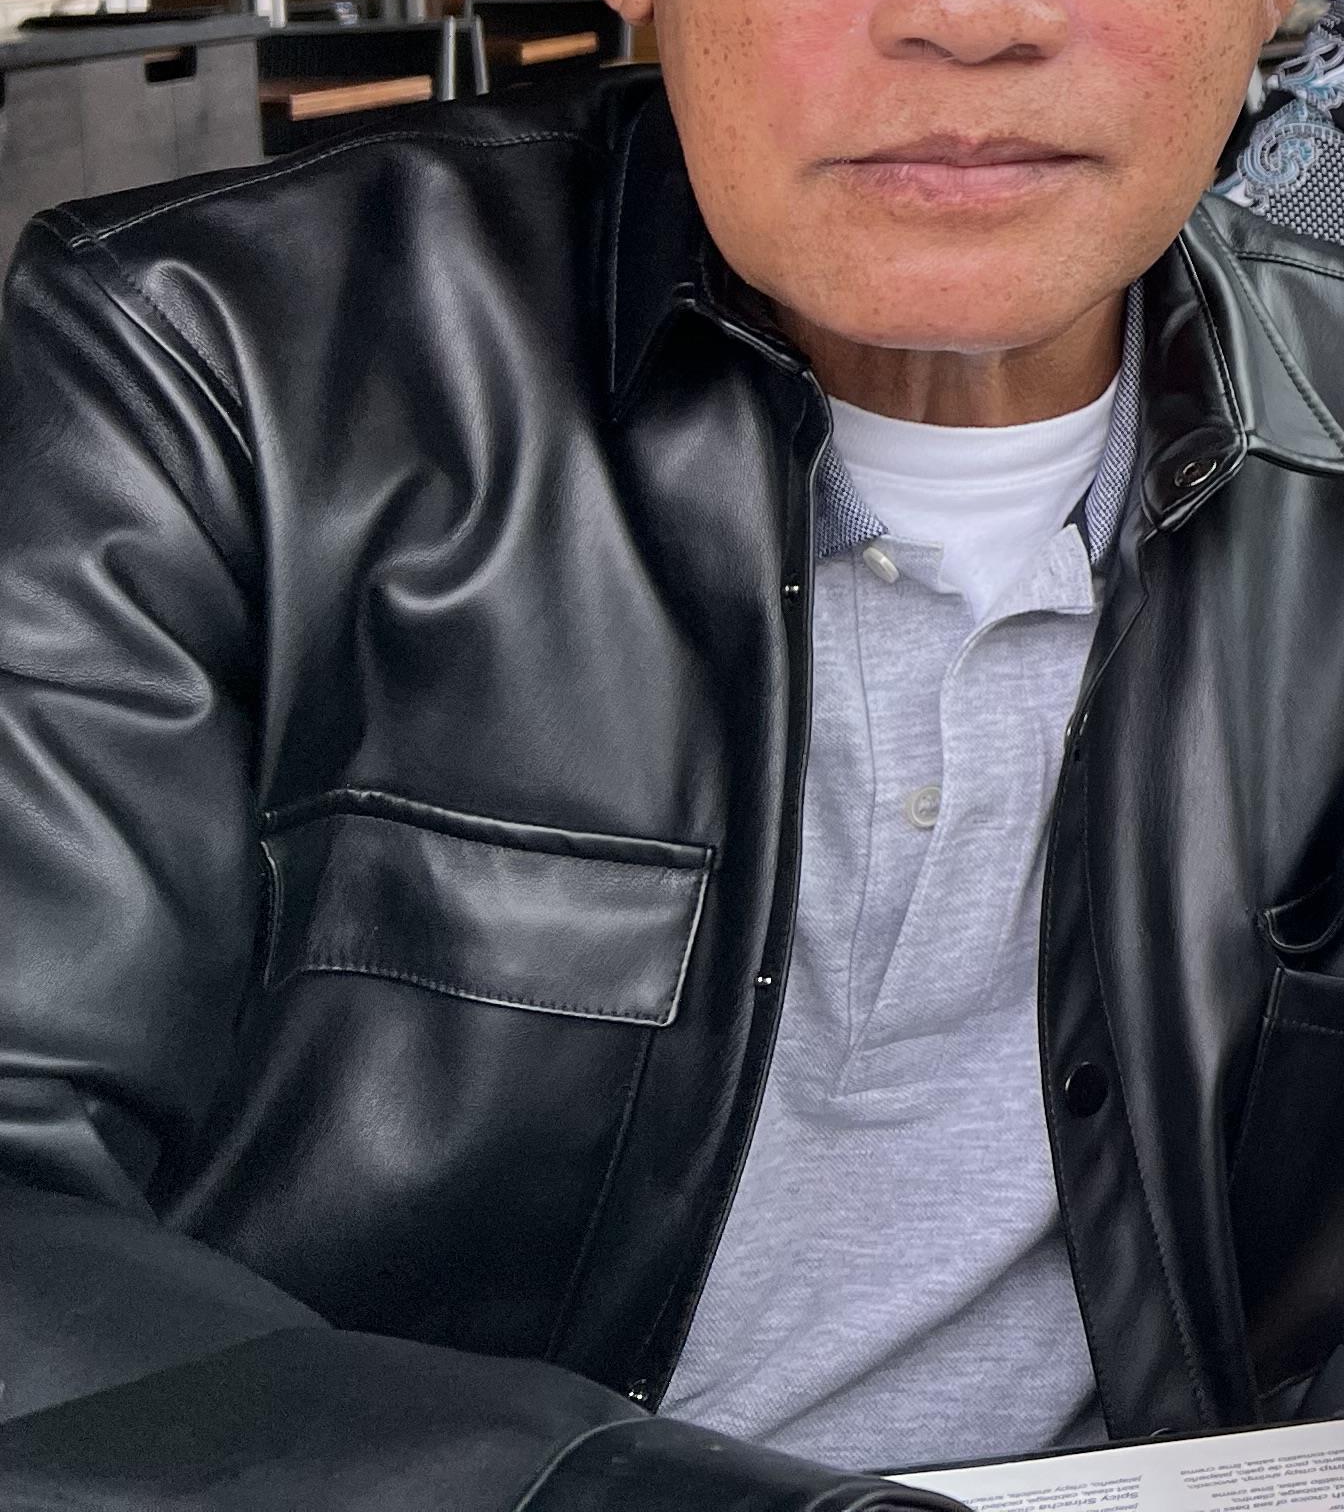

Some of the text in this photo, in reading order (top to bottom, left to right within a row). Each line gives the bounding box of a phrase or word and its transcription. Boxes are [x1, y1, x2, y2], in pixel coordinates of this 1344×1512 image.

[1284, 1467, 1317, 1476] crispy
[1101, 1492, 1138, 1501] Spicy
[1291, 1494, 1328, 1503] choice
